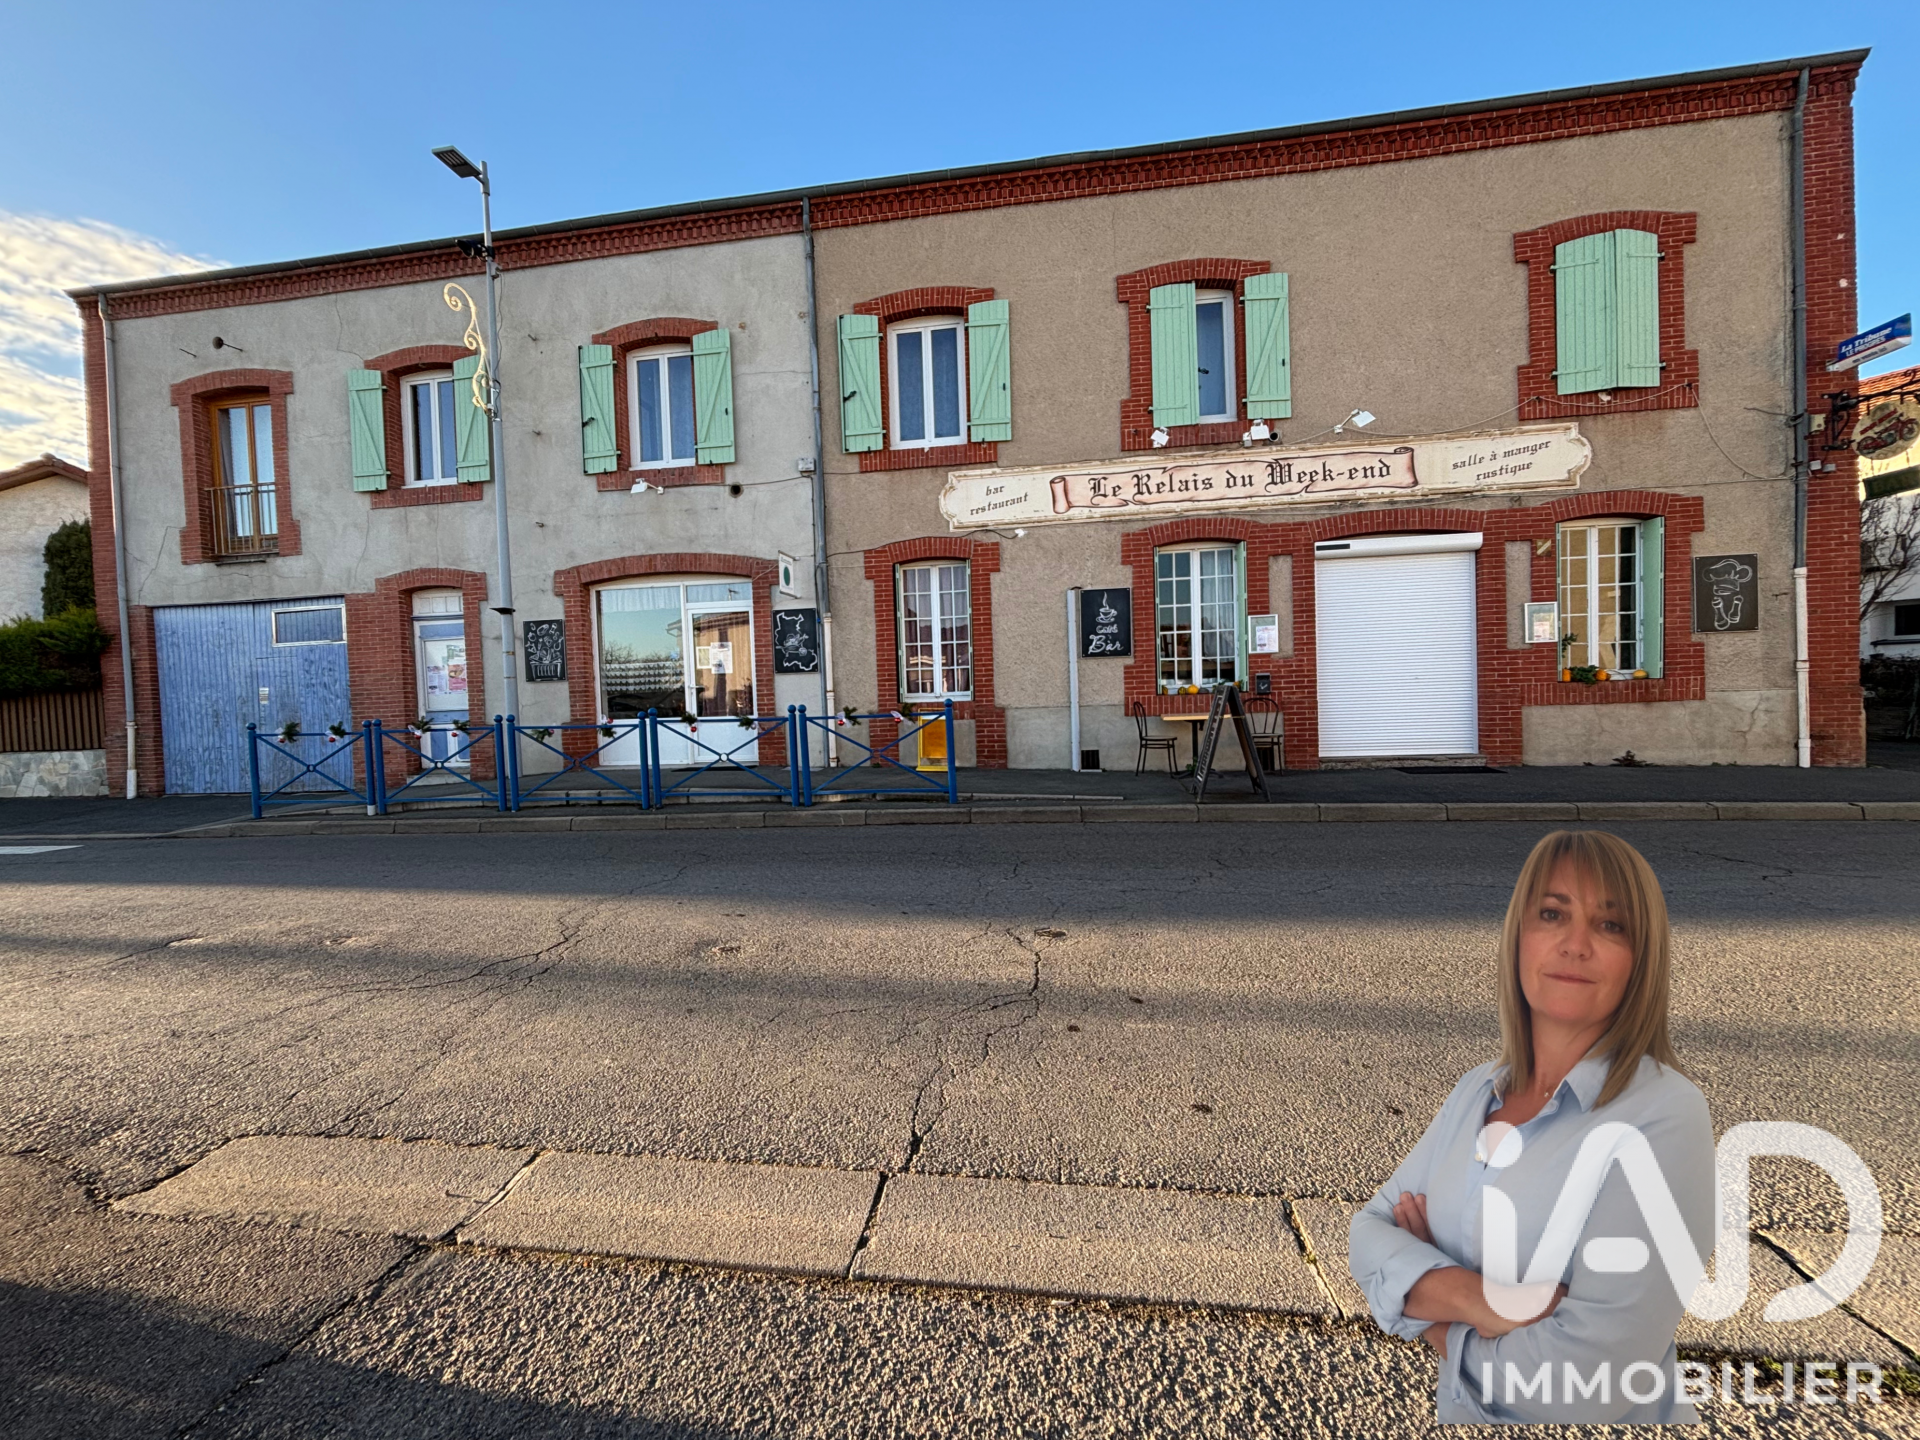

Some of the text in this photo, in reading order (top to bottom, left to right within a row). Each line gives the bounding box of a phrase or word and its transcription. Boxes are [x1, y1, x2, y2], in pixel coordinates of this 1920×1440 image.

[1841, 327, 1892, 353] La Tribune
[1451, 439, 1551, 470] salle à manger
[1087, 458, 1392, 506] Le Relais du Week-end
[1475, 460, 1533, 483] rustique
[985, 483, 1005, 497] bar
[970, 491, 1029, 516] restaurant
